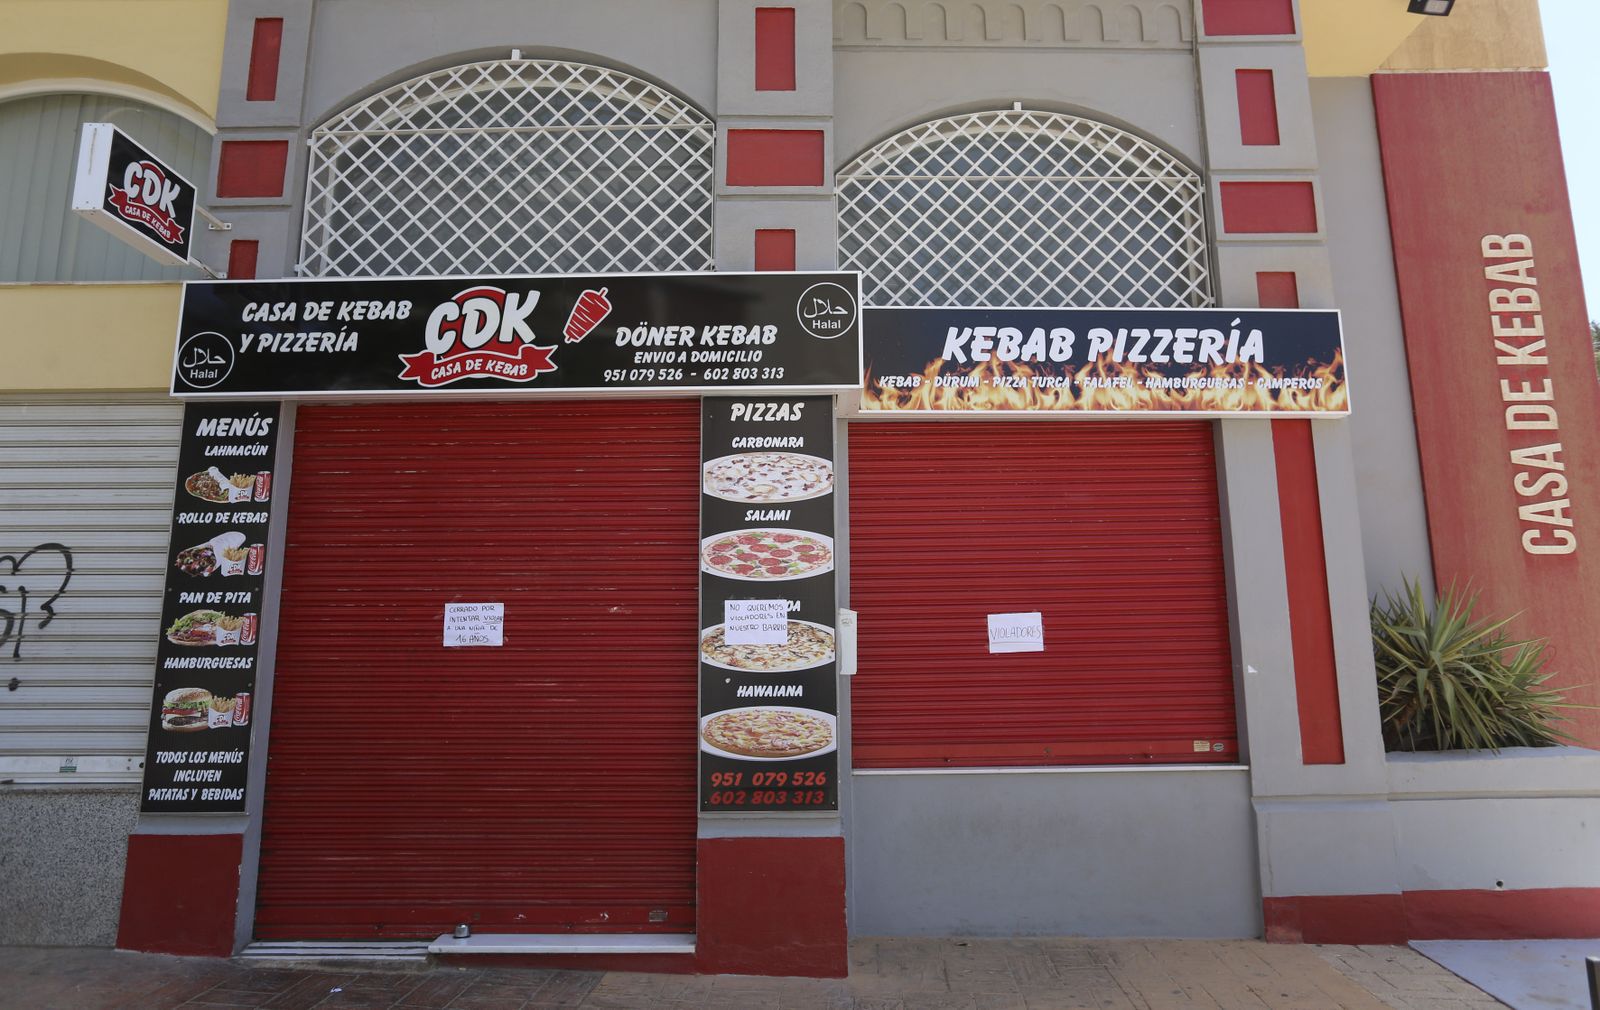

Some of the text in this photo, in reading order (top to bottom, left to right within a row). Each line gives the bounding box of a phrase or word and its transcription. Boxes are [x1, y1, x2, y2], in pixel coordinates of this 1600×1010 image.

[123, 161, 181, 218] CDK
[125, 205, 171, 239] CASA DE KEBAB
[241, 300, 412, 323] CASA DE KEBAB
[803, 297, 849, 319] حلال
[425, 290, 541, 355] CDK
[812, 319, 841, 330] Halal
[239, 326, 359, 354] Y PIZZERÍA
[614, 321, 778, 347] DÖNER KEBAB
[942, 317, 1265, 366] KEBAB PIZZERÍA
[183, 347, 226, 368] حلال
[634, 350, 763, 364] ENVIO A DOMICILIO
[190, 368, 218, 379] Halal
[431, 359, 528, 380] CASA DE KEBAB
[603, 369, 626, 382] 951
[629, 369, 654, 381] 079
[658, 368, 683, 380] 526
[703, 368, 730, 380] 602
[732, 367, 758, 380] 803
[761, 367, 785, 379] 313
[880, 376, 920, 388] KEBAB
[934, 373, 980, 388] DÜRUM
[993, 376, 1027, 388] PIZZA
[1031, 376, 1070, 388] TURCA
[1083, 376, 1133, 389] FALAFEL
[1146, 377, 1244, 389] HAMBURGUESAS
[1256, 377, 1323, 389] CAMPEROS
[1481, 233, 1577, 555] CASA DE KEBAB
[730, 403, 805, 422] PIZZAS
[196, 412, 273, 437] MENÚS
[205, 442, 269, 456] LAHMACÚN
[731, 437, 804, 448] CARBONARA
[178, 512, 268, 524] ROLLO DE KEBAB
[744, 509, 791, 521] SALAMI
[179, 592, 251, 604] PAN DE PITA
[747, 603, 783, 611] QUEREMOS
[450, 615, 480, 623] INTENTAR
[730, 613, 774, 621] VIOLADORES
[456, 634, 467, 644] 16
[990, 625, 1042, 640] VIOLADORES
[164, 657, 253, 669] HAMBURGUESAS
[737, 685, 803, 697] HAWAIANA
[156, 748, 244, 764] TODOS LOS MENÚS
[173, 770, 222, 782] INCLUYEN
[711, 772, 826, 787] 951 079 526
[149, 788, 244, 801] PATATAS Y BEBIDAS
[710, 790, 824, 805] 602 803 313
